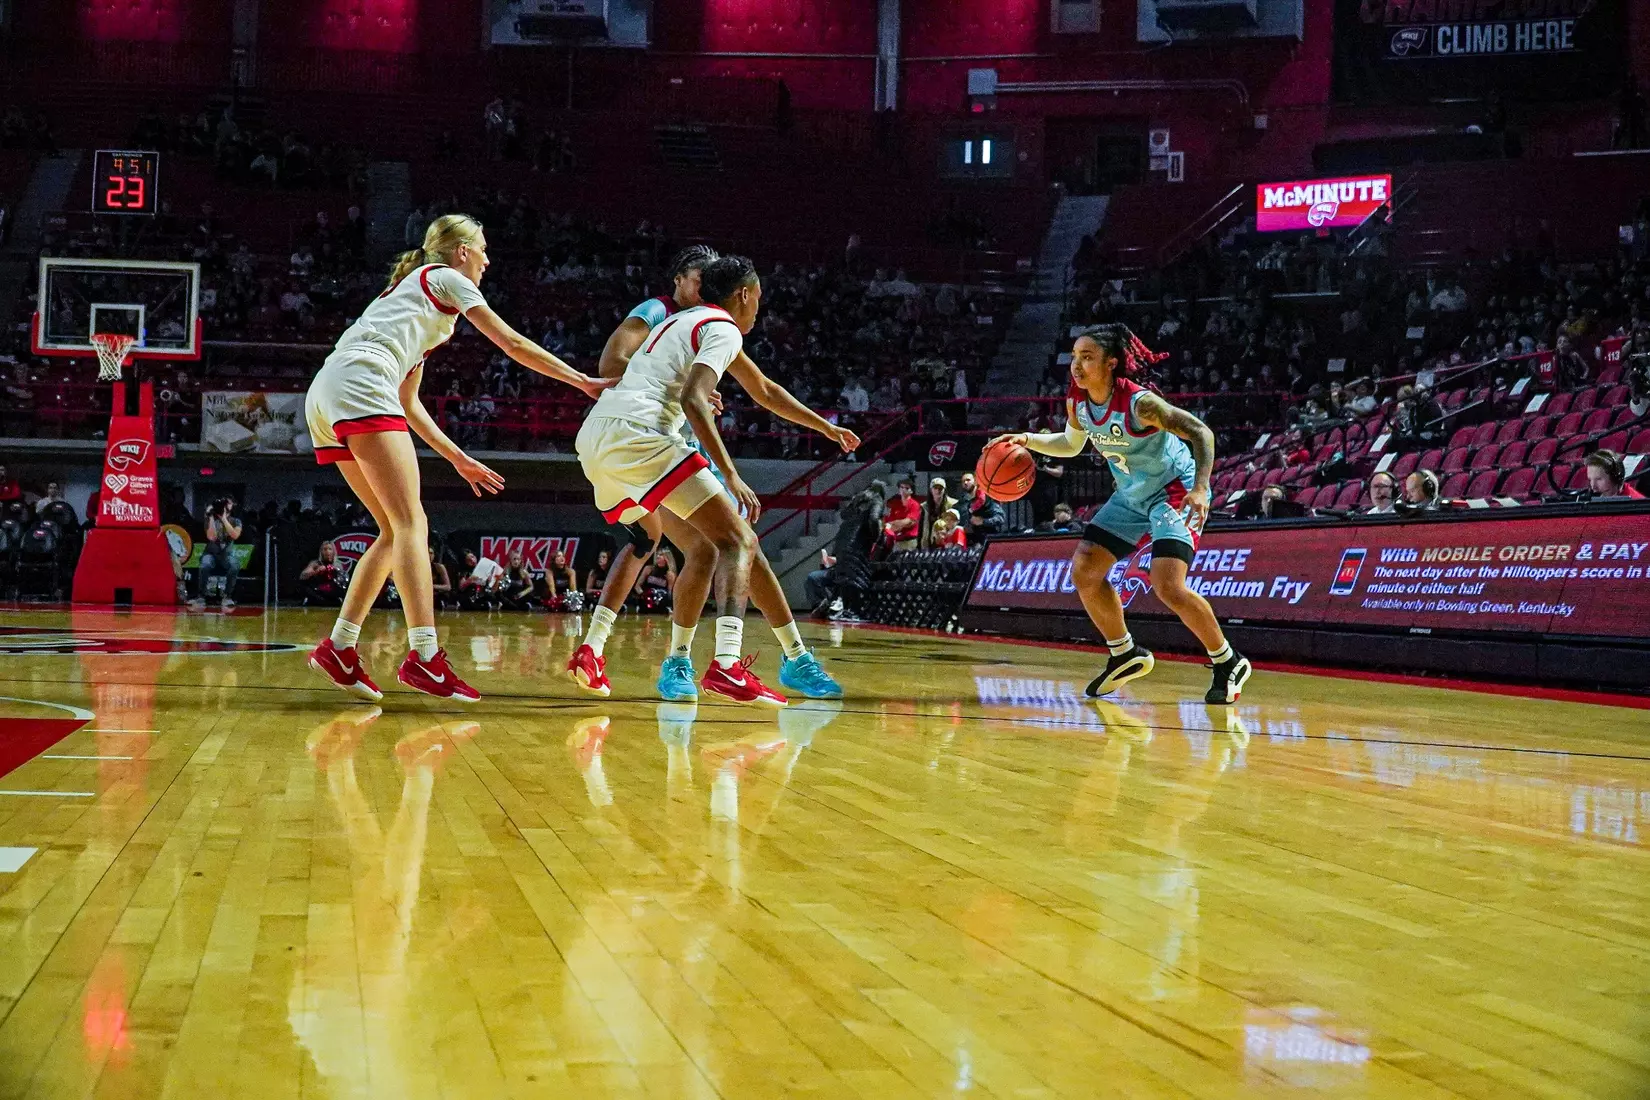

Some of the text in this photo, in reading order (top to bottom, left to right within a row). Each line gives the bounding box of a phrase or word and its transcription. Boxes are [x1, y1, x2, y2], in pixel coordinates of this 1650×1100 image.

[1437, 20, 1575, 55] CLIMB HERE
[106, 175, 145, 208] 23
[1263, 178, 1387, 209] McMINUTE
[119, 444, 140, 455] WKU
[340, 541, 367, 553] WKU
[480, 536, 580, 572] WKU
[1380, 542, 1649, 562] With MOBILE ORDER & PAY
[1190, 549, 1251, 572] FREE
[1373, 566, 1394, 578] The
[1394, 567, 1420, 578] next
[1421, 567, 1442, 580] day
[1444, 566, 1476, 578] after
[1477, 566, 1499, 578] the
[1501, 565, 1578, 581] Hilltoppers
[1580, 567, 1624, 579] score
[1626, 566, 1642, 578] in
[1185, 576, 1312, 604] Medium Fry
[1366, 582, 1486, 595] minute of either half
[1361, 598, 1403, 609] Available
[1403, 600, 1425, 612] only
[1425, 600, 1435, 611] in
[1436, 600, 1478, 614] Bowling
[1517, 601, 1576, 618] Kentucky
